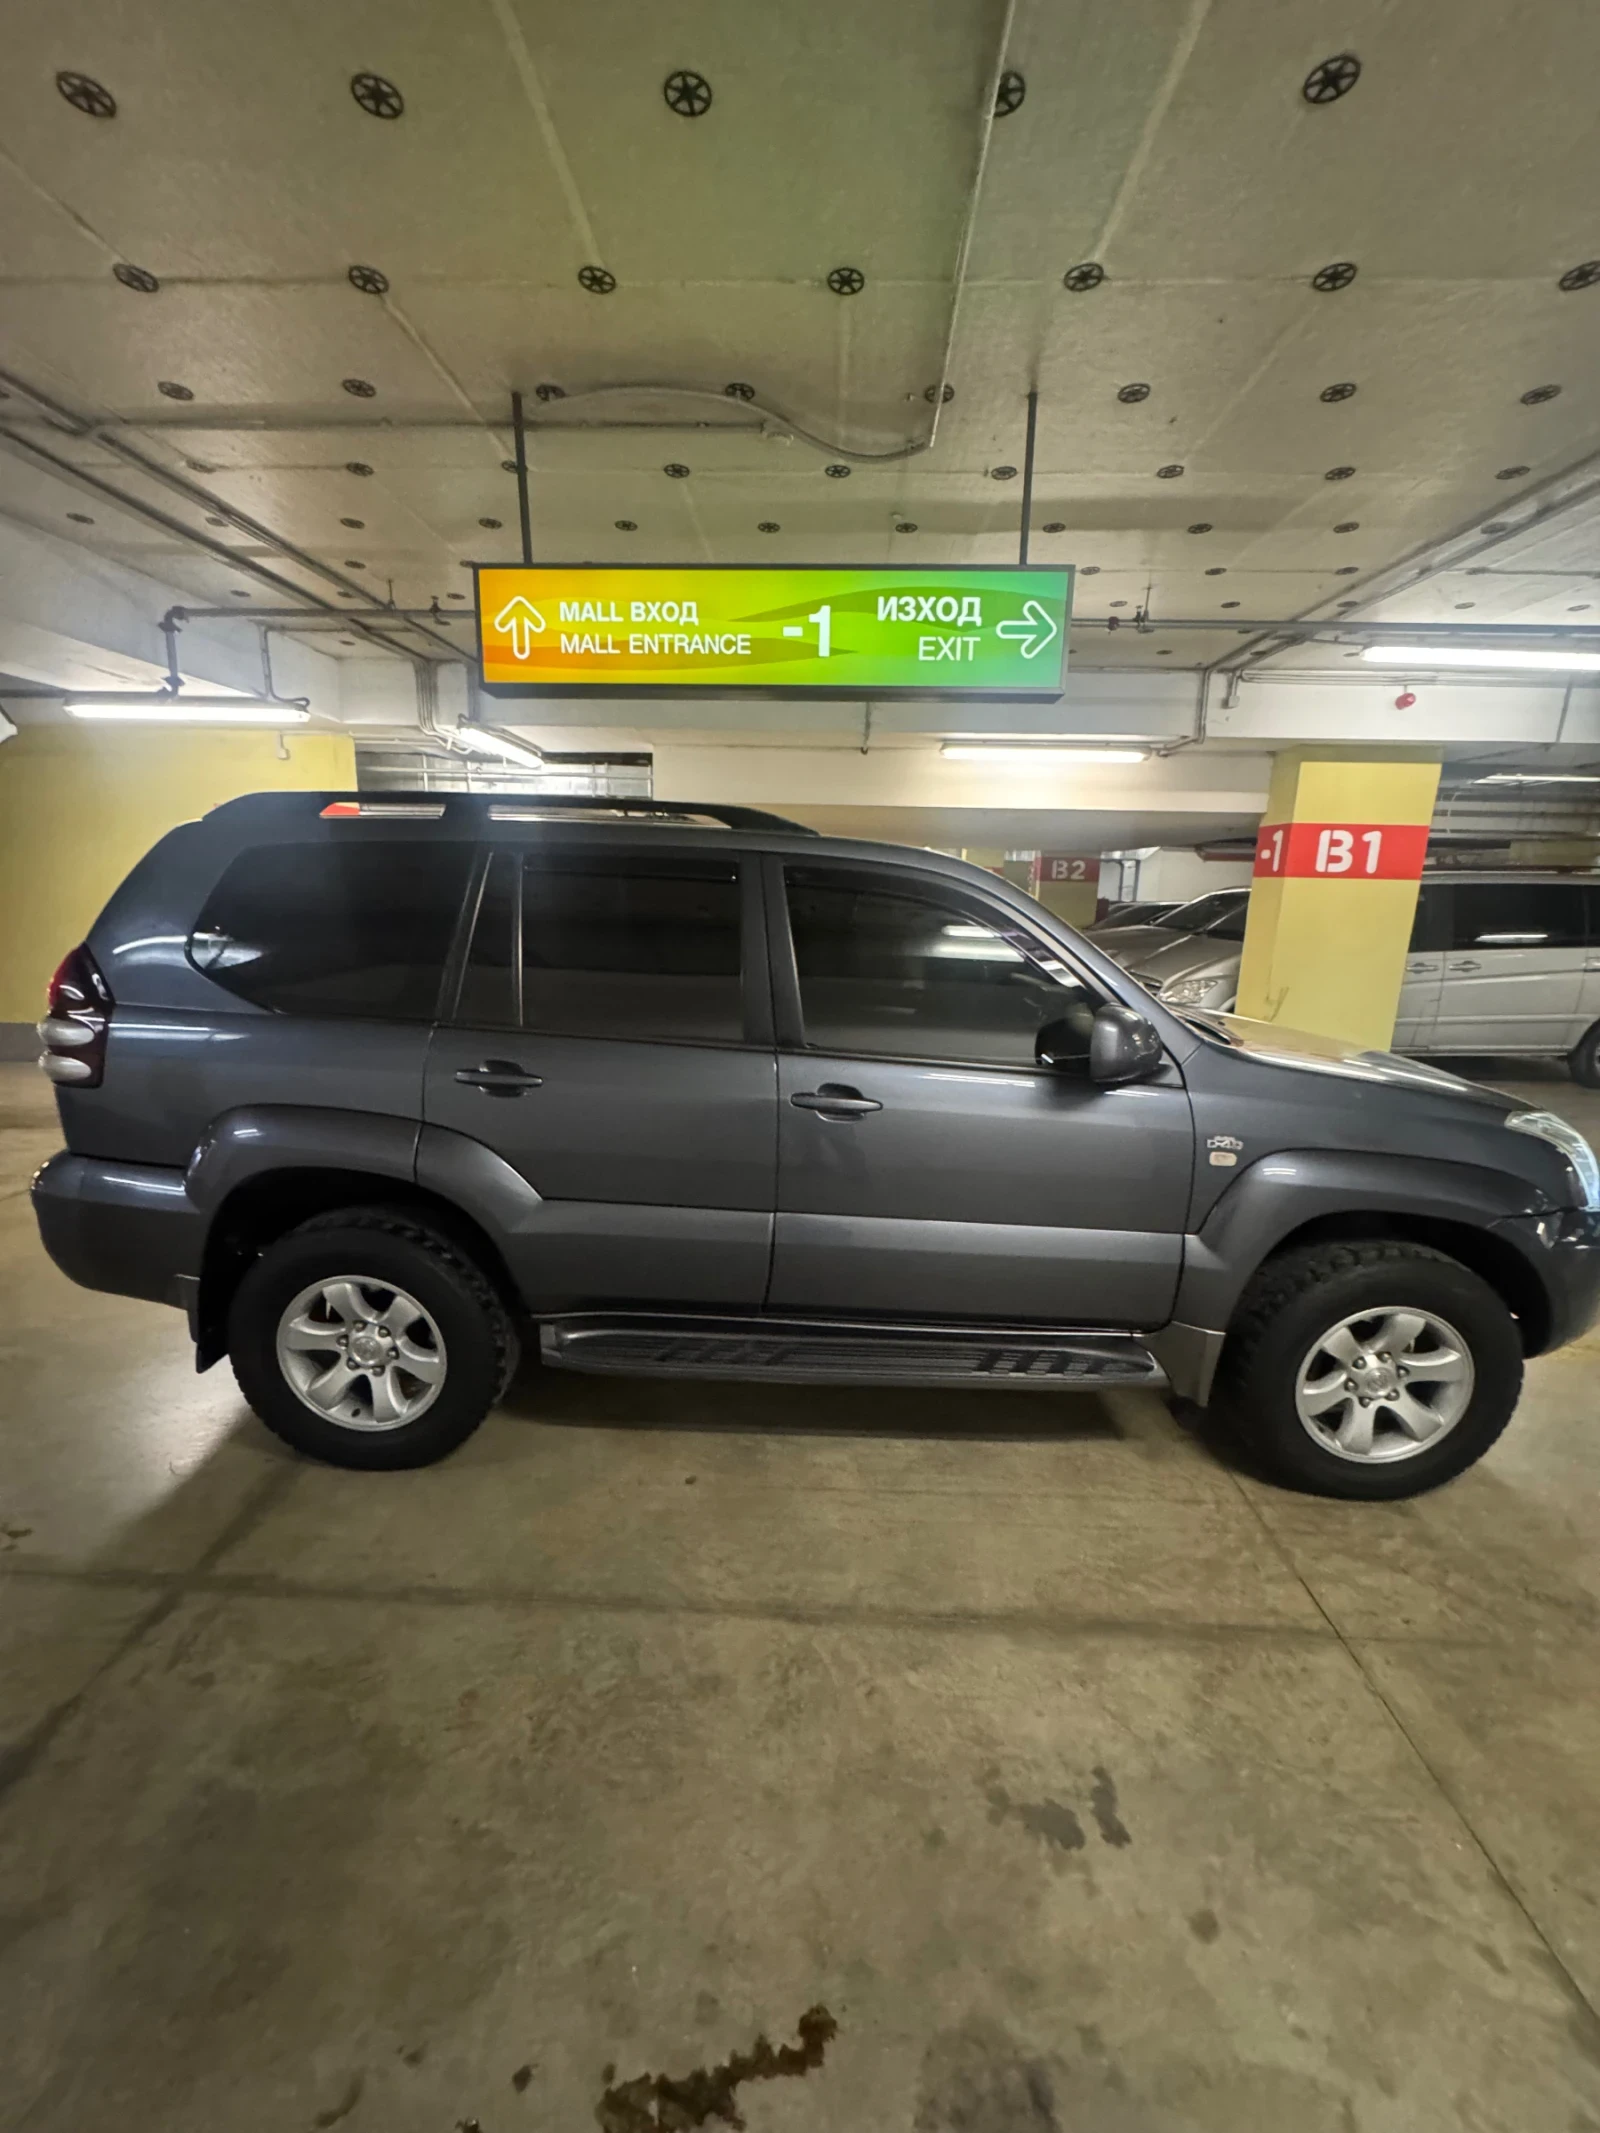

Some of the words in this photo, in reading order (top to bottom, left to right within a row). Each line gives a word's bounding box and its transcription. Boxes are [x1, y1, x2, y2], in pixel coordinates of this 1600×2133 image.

[559, 601, 624, 623] MALL
[630, 601, 699, 626] ВХОД
[877, 596, 982, 627] ИЗХОД
[783, 604, 831, 658] -1
[560, 633, 621, 654] MALL
[629, 633, 752, 655] ENTRANCE
[918, 636, 981, 661] EXIT
[1315, 829, 1382, 874] B1
[1051, 859, 1086, 880] B2
